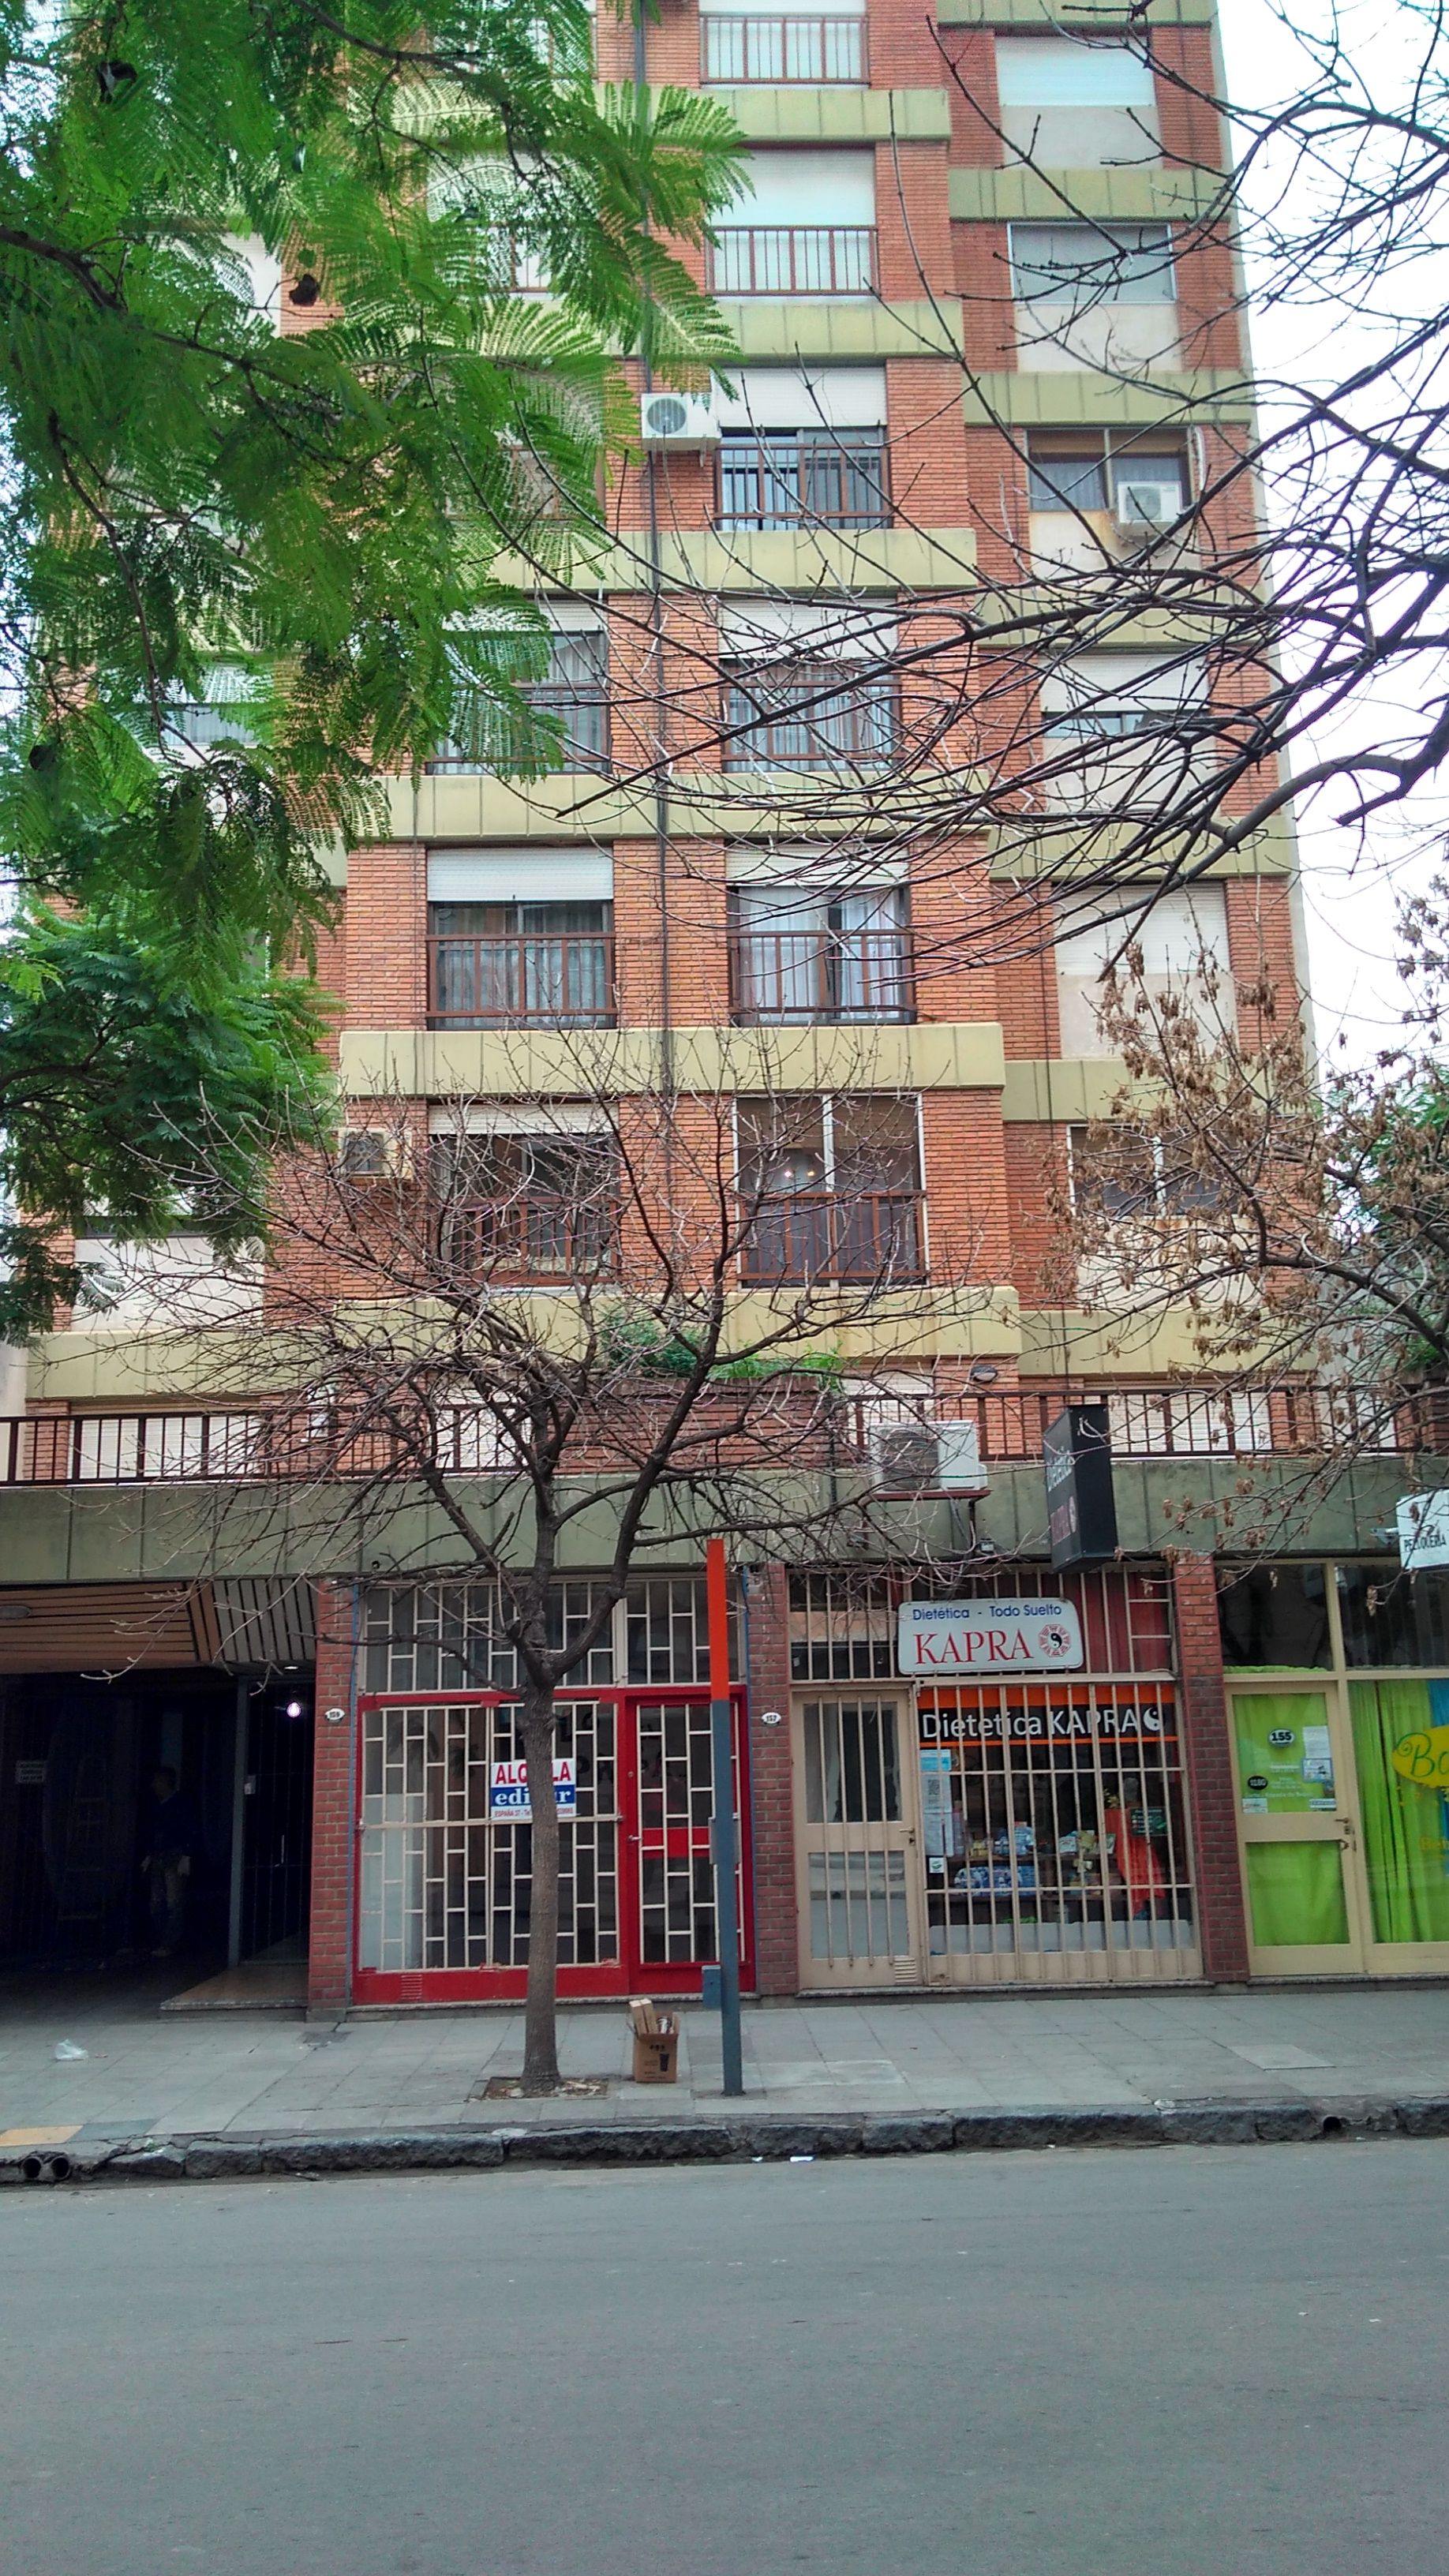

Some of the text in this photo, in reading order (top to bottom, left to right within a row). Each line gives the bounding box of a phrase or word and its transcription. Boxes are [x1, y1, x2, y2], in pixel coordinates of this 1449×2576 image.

[913, 1607, 970, 1620] Dietética
[989, 1604, 1020, 1617] Todo
[1024, 1603, 1062, 1616] Suelto
[913, 1628, 1035, 1664] KAPRA
[922, 1708, 1139, 1738] Dietetica KAPRA
[1271, 1732, 1292, 1742] 155
[495, 1761, 571, 1785] ALQLA
